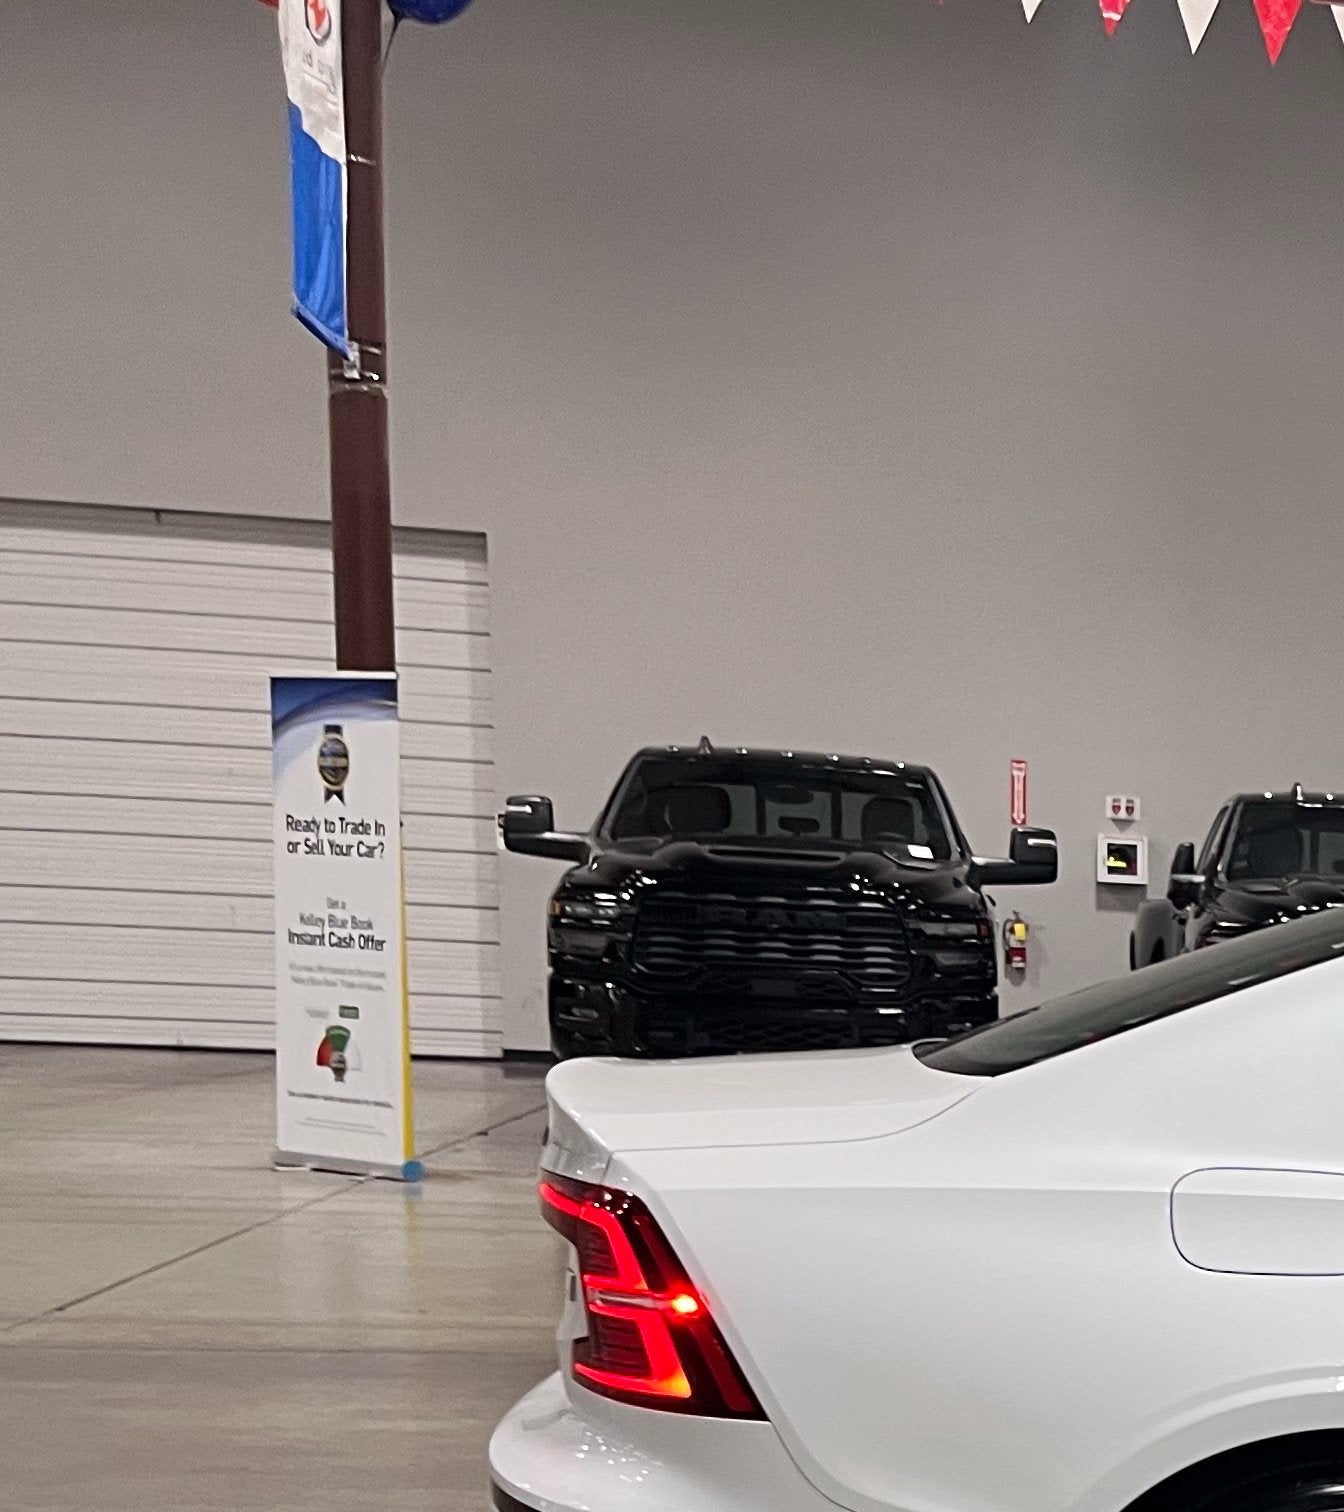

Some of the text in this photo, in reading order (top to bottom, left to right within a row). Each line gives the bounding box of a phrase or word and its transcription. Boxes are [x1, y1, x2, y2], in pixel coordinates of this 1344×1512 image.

[286, 813, 386, 839] Ready to Trade In
[287, 837, 385, 860] or Sell Your Car?
[328, 931, 355, 949] Cash
[358, 933, 386, 952] Offer
